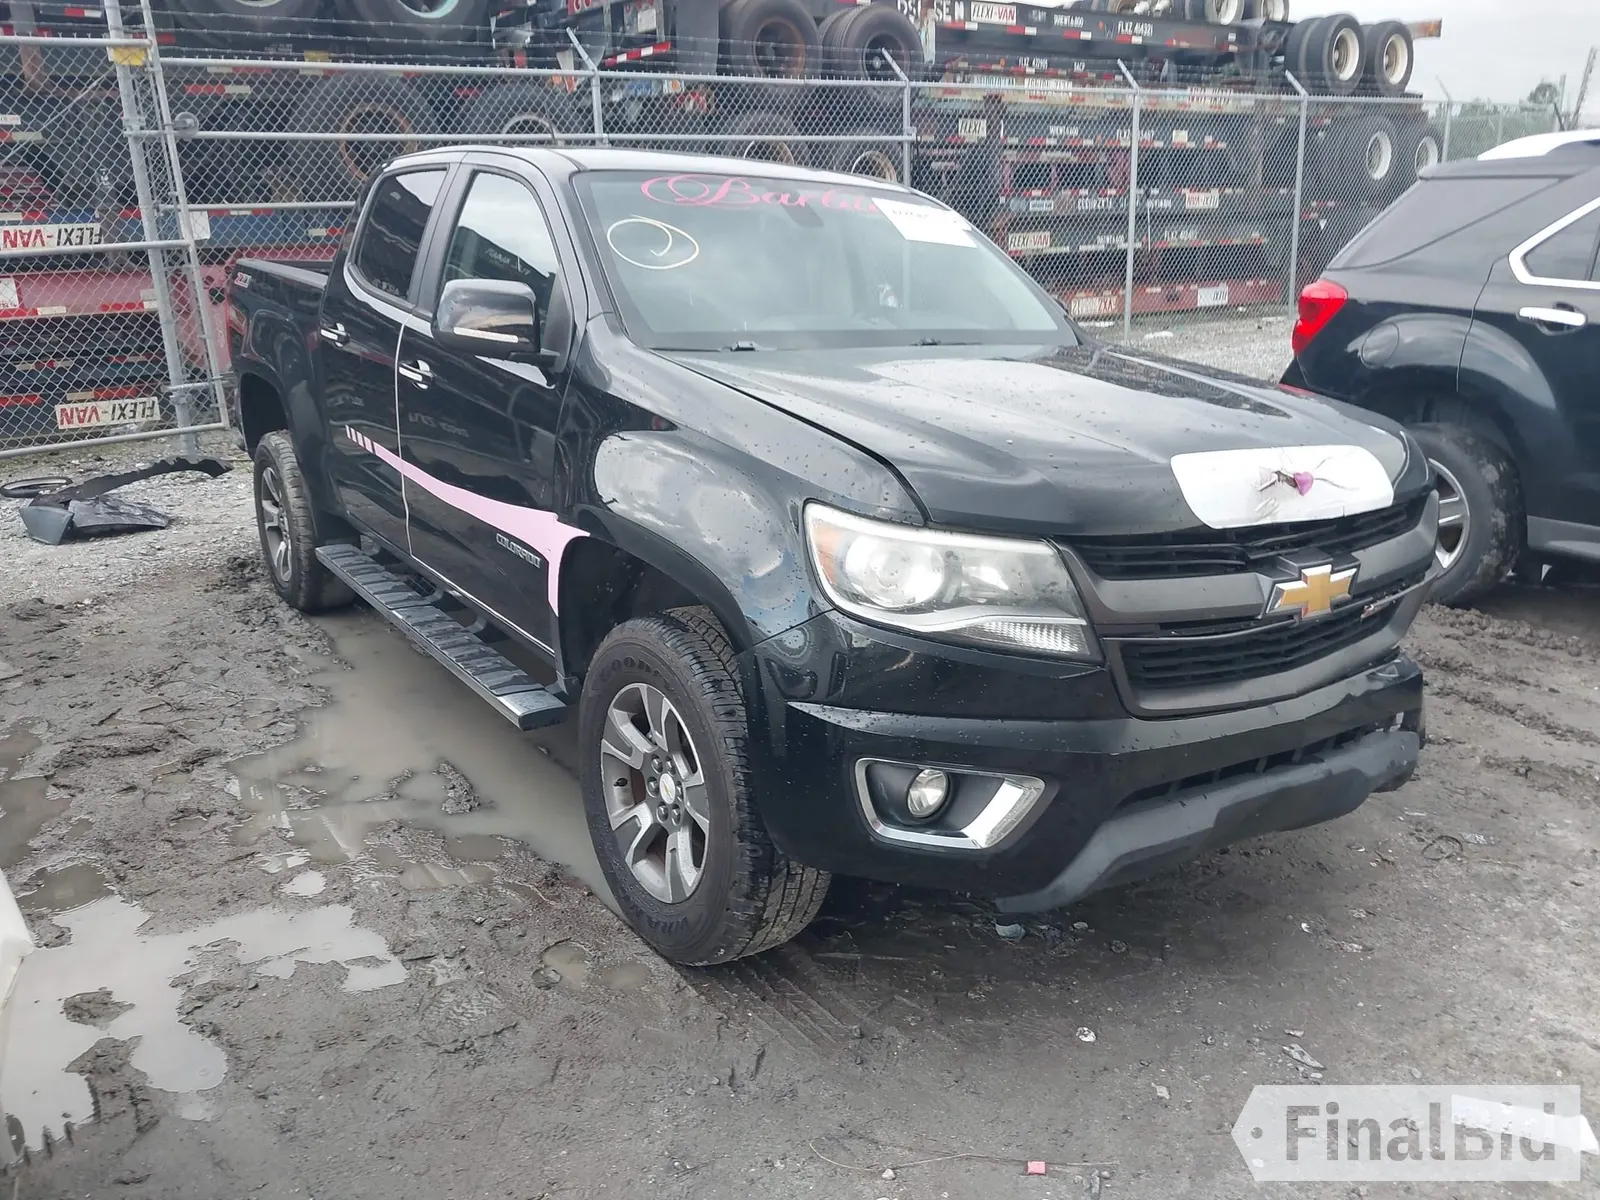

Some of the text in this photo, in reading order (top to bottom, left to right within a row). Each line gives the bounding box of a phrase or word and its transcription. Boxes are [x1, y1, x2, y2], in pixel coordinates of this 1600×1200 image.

[972, 4, 1015, 20] FLEXI-VAN
[3, 226, 102, 249] FLEXI-VAN
[59, 400, 156, 426] FLEXI-VAN
